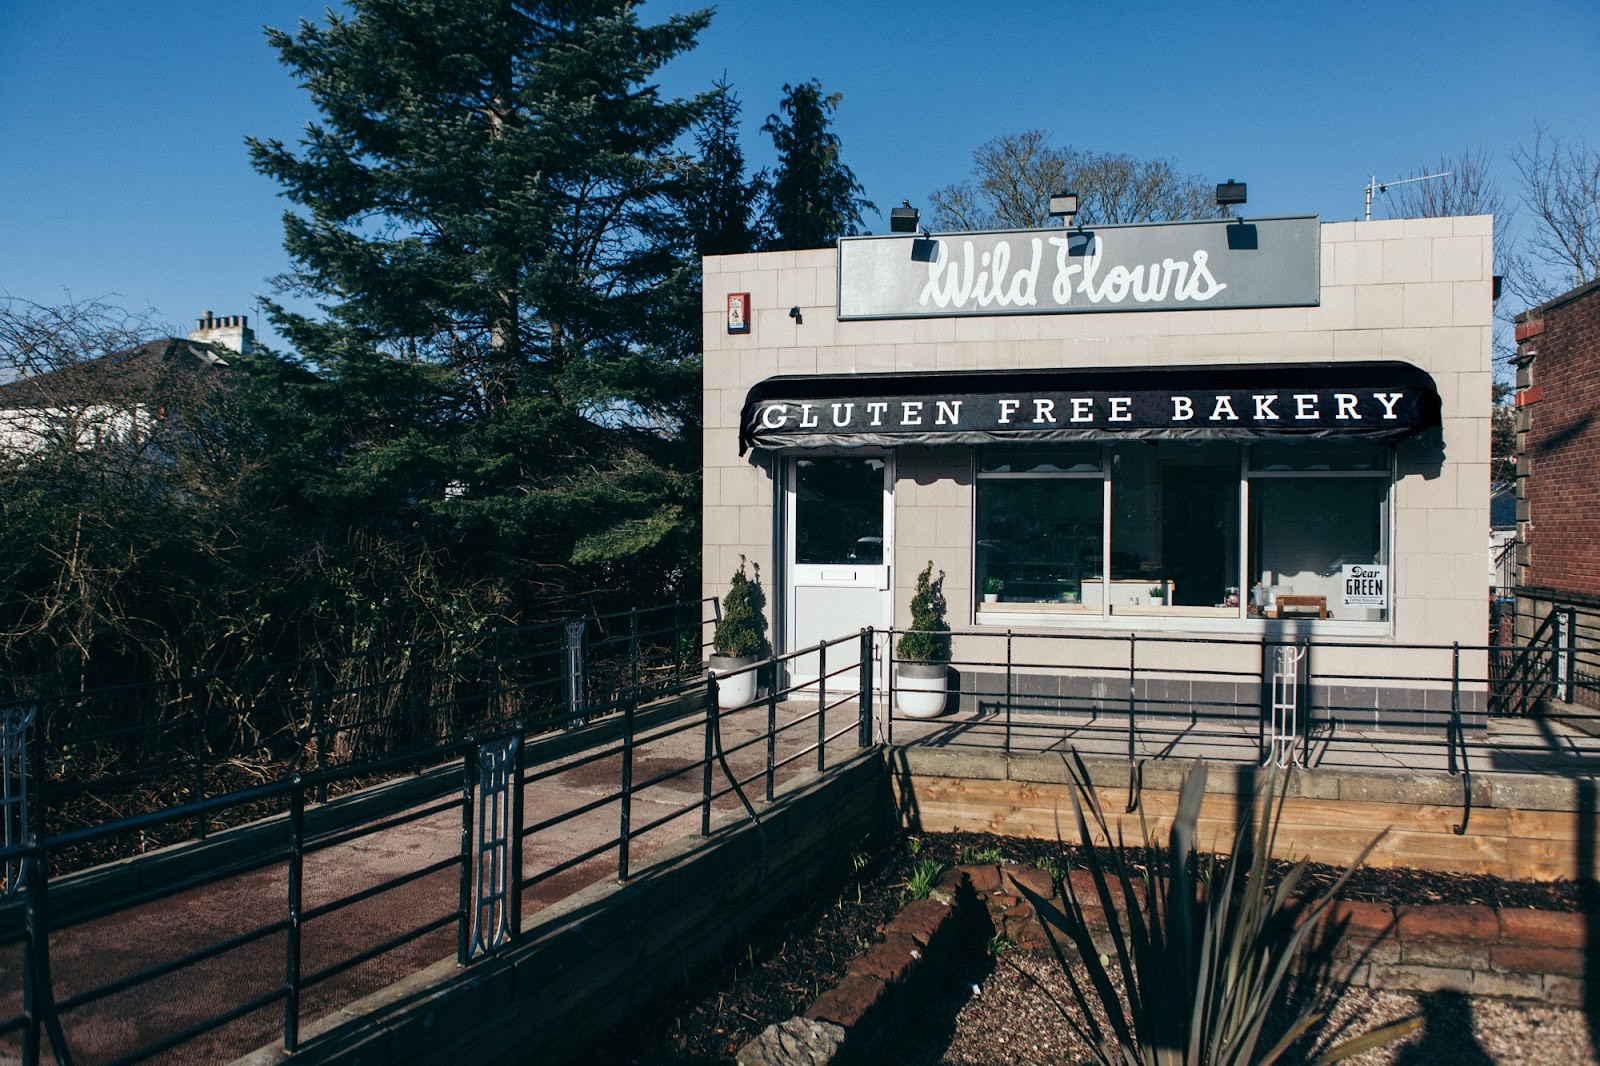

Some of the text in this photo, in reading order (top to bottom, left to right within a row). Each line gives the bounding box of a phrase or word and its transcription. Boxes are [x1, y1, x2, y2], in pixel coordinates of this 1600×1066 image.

[919, 235, 1227, 309] Wild Flours
[762, 393, 1403, 429] GLUTEN FREE BAKERY
[1351, 566, 1380, 578] Dear
[1346, 579, 1383, 595] GREEN
